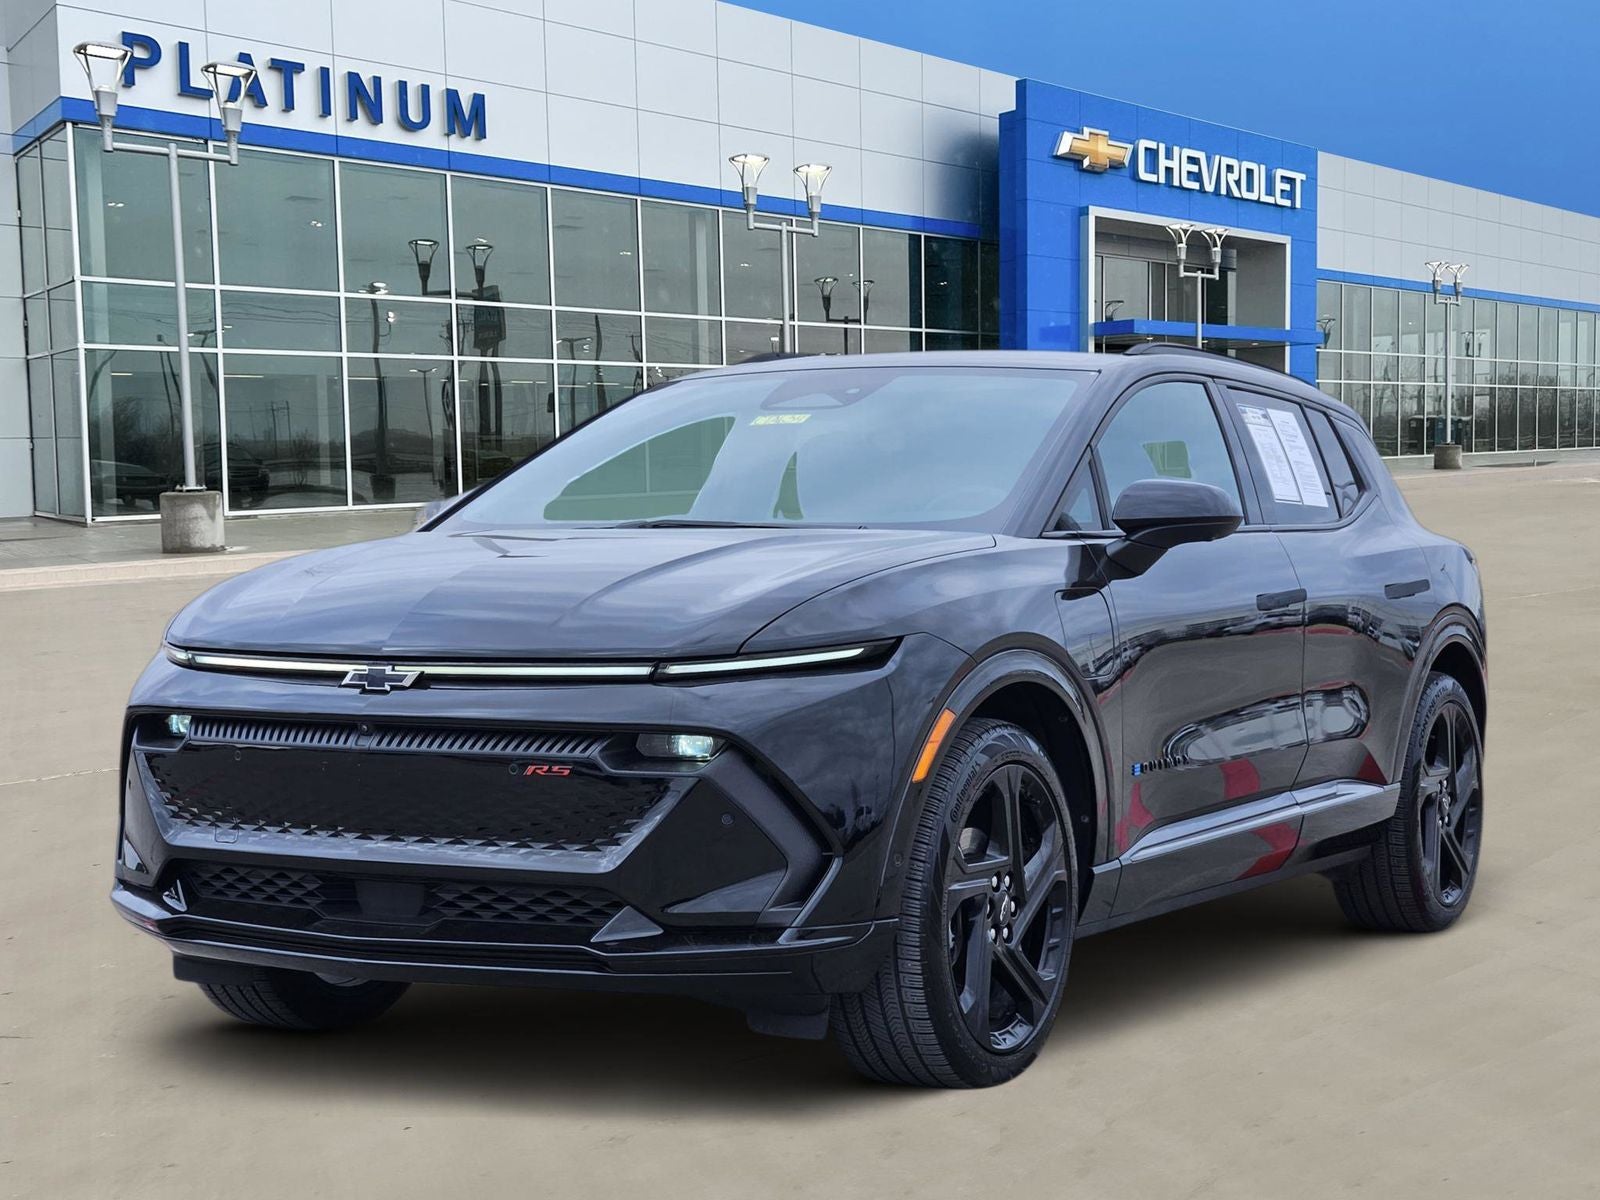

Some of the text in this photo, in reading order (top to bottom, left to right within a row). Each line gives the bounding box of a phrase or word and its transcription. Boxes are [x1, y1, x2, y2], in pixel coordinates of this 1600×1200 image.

[119, 31, 487, 140] PLATINUM
[1136, 139, 1306, 208] CHEVROLET
[523, 765, 574, 775] RS
